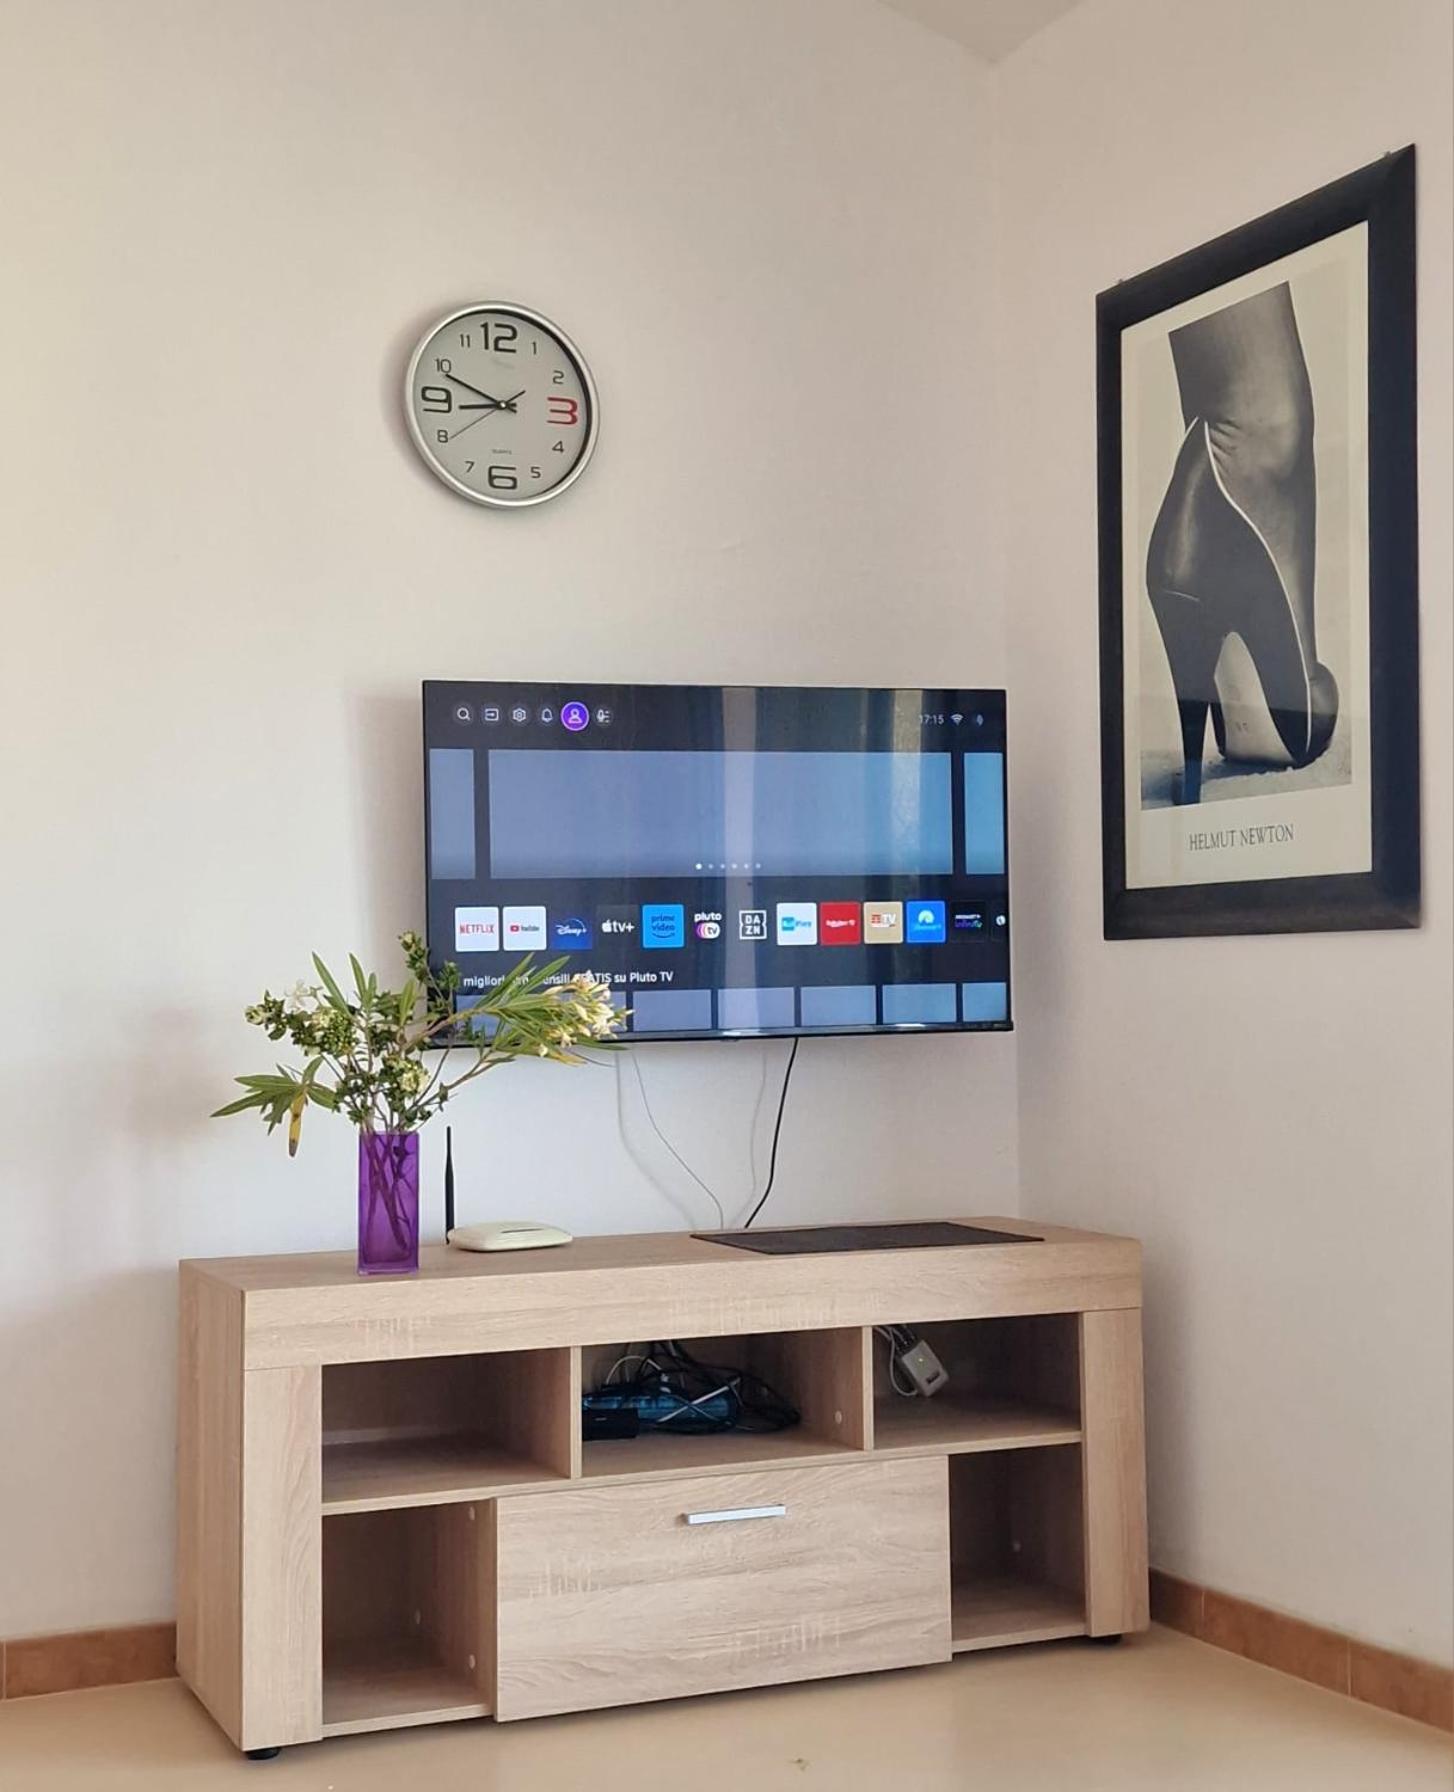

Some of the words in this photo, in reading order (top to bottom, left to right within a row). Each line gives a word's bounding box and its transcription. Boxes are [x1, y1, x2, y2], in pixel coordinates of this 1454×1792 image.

[459, 334, 471, 348] 11
[480, 321, 518, 353] 12
[532, 341, 537, 355] 1
[435, 358, 452, 374] 10
[552, 370, 565, 385] 2
[421, 386, 452, 414] 9
[547, 396, 578, 425] 3
[437, 429, 449, 444] 8
[552, 440, 564, 453] 4
[464, 461, 475, 473] 7
[530, 466, 541, 479] 5
[488, 465, 518, 490] 6
[919, 714, 945, 725] 17:15
[1189, 829, 1237, 851] HELMUT
[1240, 823, 1294, 846] NEWTON
[694, 912, 722, 923] pluto
[745, 914, 760, 925] DA
[460, 924, 495, 934] NETFLIX
[745, 925, 760, 935] ZN
[613, 973, 627, 983] su
[629, 971, 657, 983] Pluto
[659, 971, 674, 982] TV
